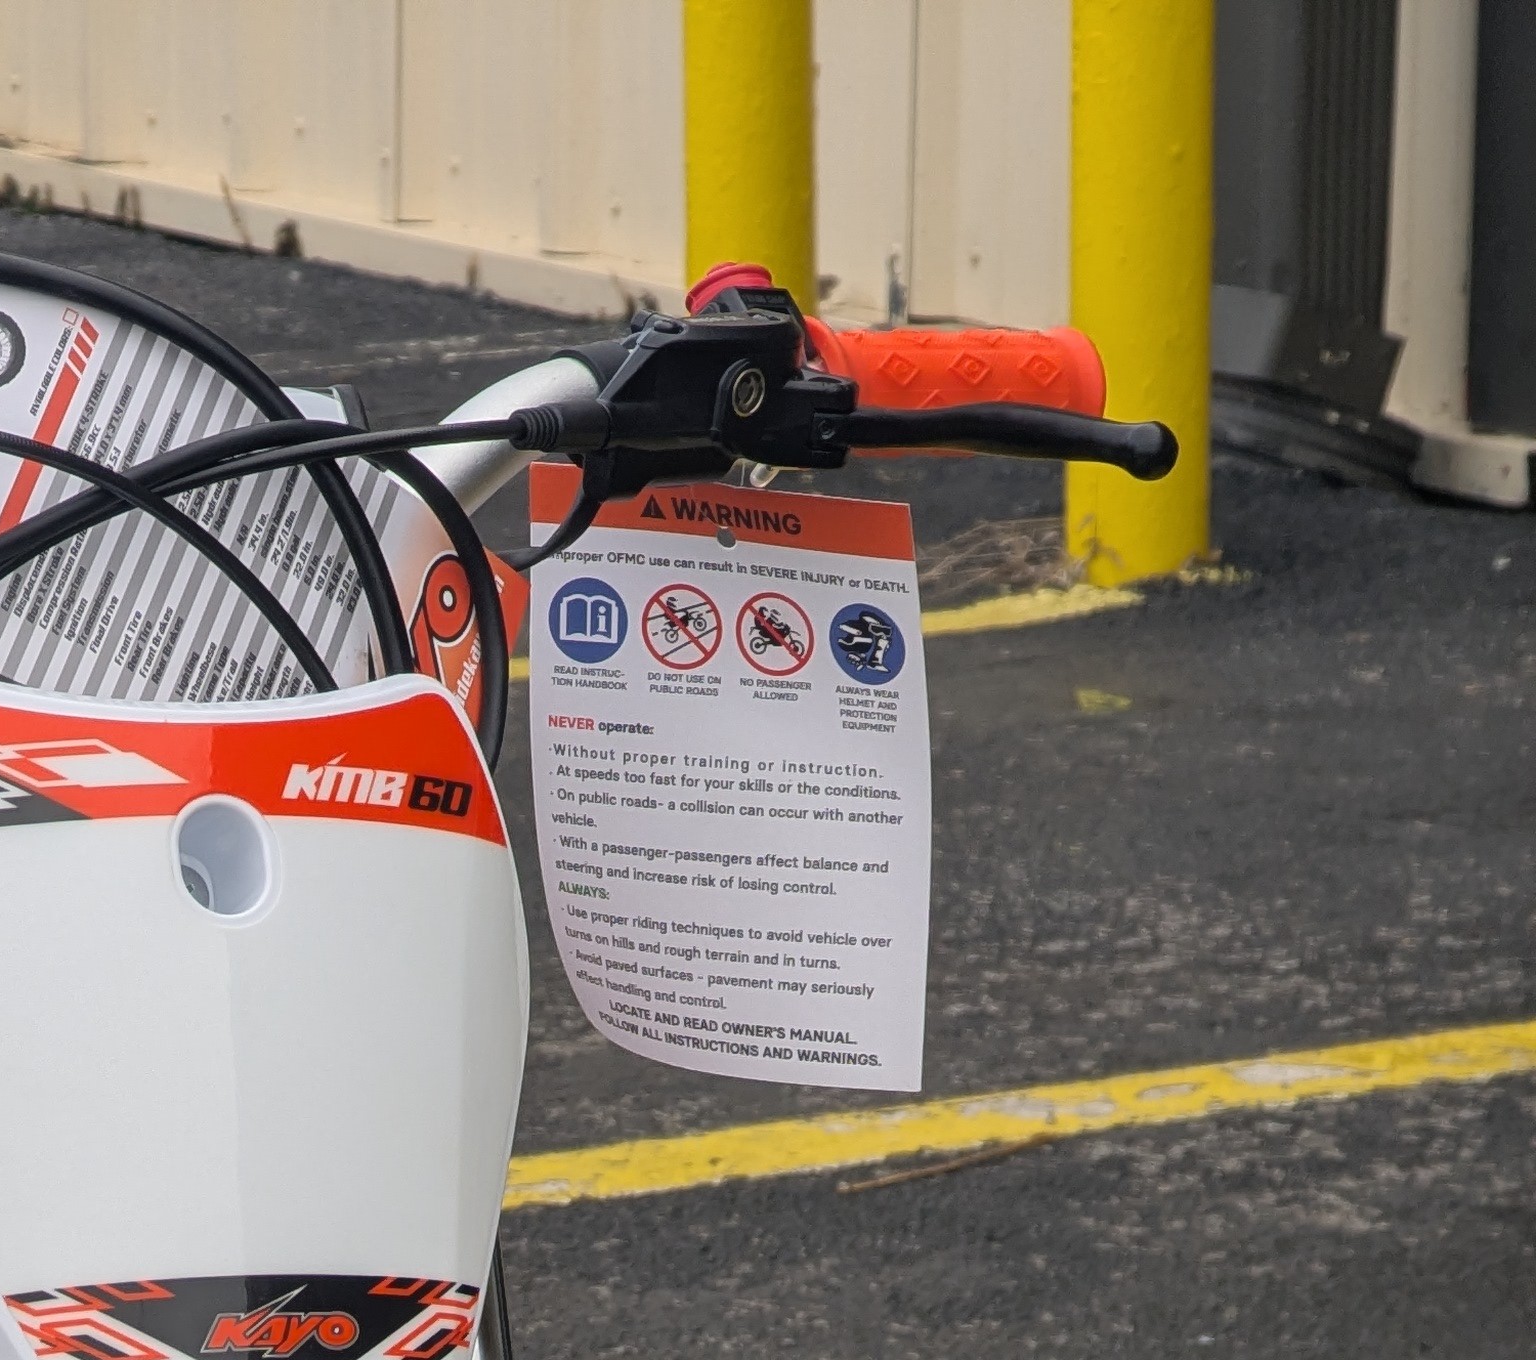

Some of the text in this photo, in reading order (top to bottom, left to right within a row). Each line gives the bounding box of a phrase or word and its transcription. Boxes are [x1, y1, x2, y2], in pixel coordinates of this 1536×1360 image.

[671, 497, 801, 535] WARNING
[42, 546, 64, 586] Stroke
[607, 552, 909, 593] OFMC use can result in SEVERE INJURY or DEATH.
[1, 571, 22, 611] Engine
[39, 555, 75, 629] Compression
[50, 565, 86, 635] Fuel System
[77, 570, 114, 646] Transmission
[64, 596, 88, 641] Ignition
[89, 594, 119, 653] Final Drive
[114, 610, 142, 666] Front Tire
[126, 619, 153, 672] Rear Tire
[139, 605, 174, 678] Front Brakes
[151, 615, 184, 684] Rear Brakes
[215, 645, 230, 673] Type
[176, 651, 199, 697] Lighting
[187, 641, 218, 702] Wheelbase
[232, 651, 257, 700] Capacity
[261, 643, 288, 696] Clearance
[552, 677, 628, 690] TION HANDBOOK
[554, 666, 625, 678] READ INSTRUC-
[647, 672, 661, 681] DO
[664, 673, 684, 682] NOT
[686, 674, 704, 683] USE
[740, 678, 812, 690] NO PASSENGER
[650, 684, 718, 696] PUBLIC ROADS
[753, 691, 798, 701] ALLOWED
[836, 685, 900, 699] ALWAYS WEAR
[839, 697, 897, 710] HELMET AND
[548, 715, 654, 735] NEVER operate:
[840, 709, 897, 722] PROTECTION
[842, 721, 896, 733] EQUIPMENT
[556, 764, 901, 800] At speeds too fast for your skills or the conditions.
[623, 751, 676, 766] proper
[684, 754, 749, 773] training
[758, 760, 774, 770] or
[782, 759, 884, 778] instruction.
[552, 812, 597, 828] vehicle.
[557, 788, 575, 801] On
[579, 791, 617, 805] public
[668, 802, 675, 810] a
[680, 800, 735, 815] collision
[739, 805, 764, 817] can
[769, 808, 809, 819] occur
[814, 808, 843, 822] with
[849, 811, 903, 825] another
[560, 835, 889, 873] With a passenger-passengers affect balance and
[555, 859, 836, 895] steering and increase risk of losing control.
[558, 881, 610, 900] ALWAYS:
[566, 904, 892, 948] Use proper riding techniques to avoid vehicle over
[565, 926, 840, 970] turns on hills and rough terrain and in turns.
[576, 949, 875, 1000] Avoid paved surfaces pavement may seriously
[606, 978, 651, 1001] handling
[655, 991, 676, 1002] and
[679, 997, 727, 1009] control.
[599, 1011, 882, 1067] FOLLOW ALL INSTRUCTIONS AND WARNINGS.
[609, 999, 857, 1045] LOCATE AND READ OWNER'S MANUAL.
[201, 1284, 360, 1358] KAYO
